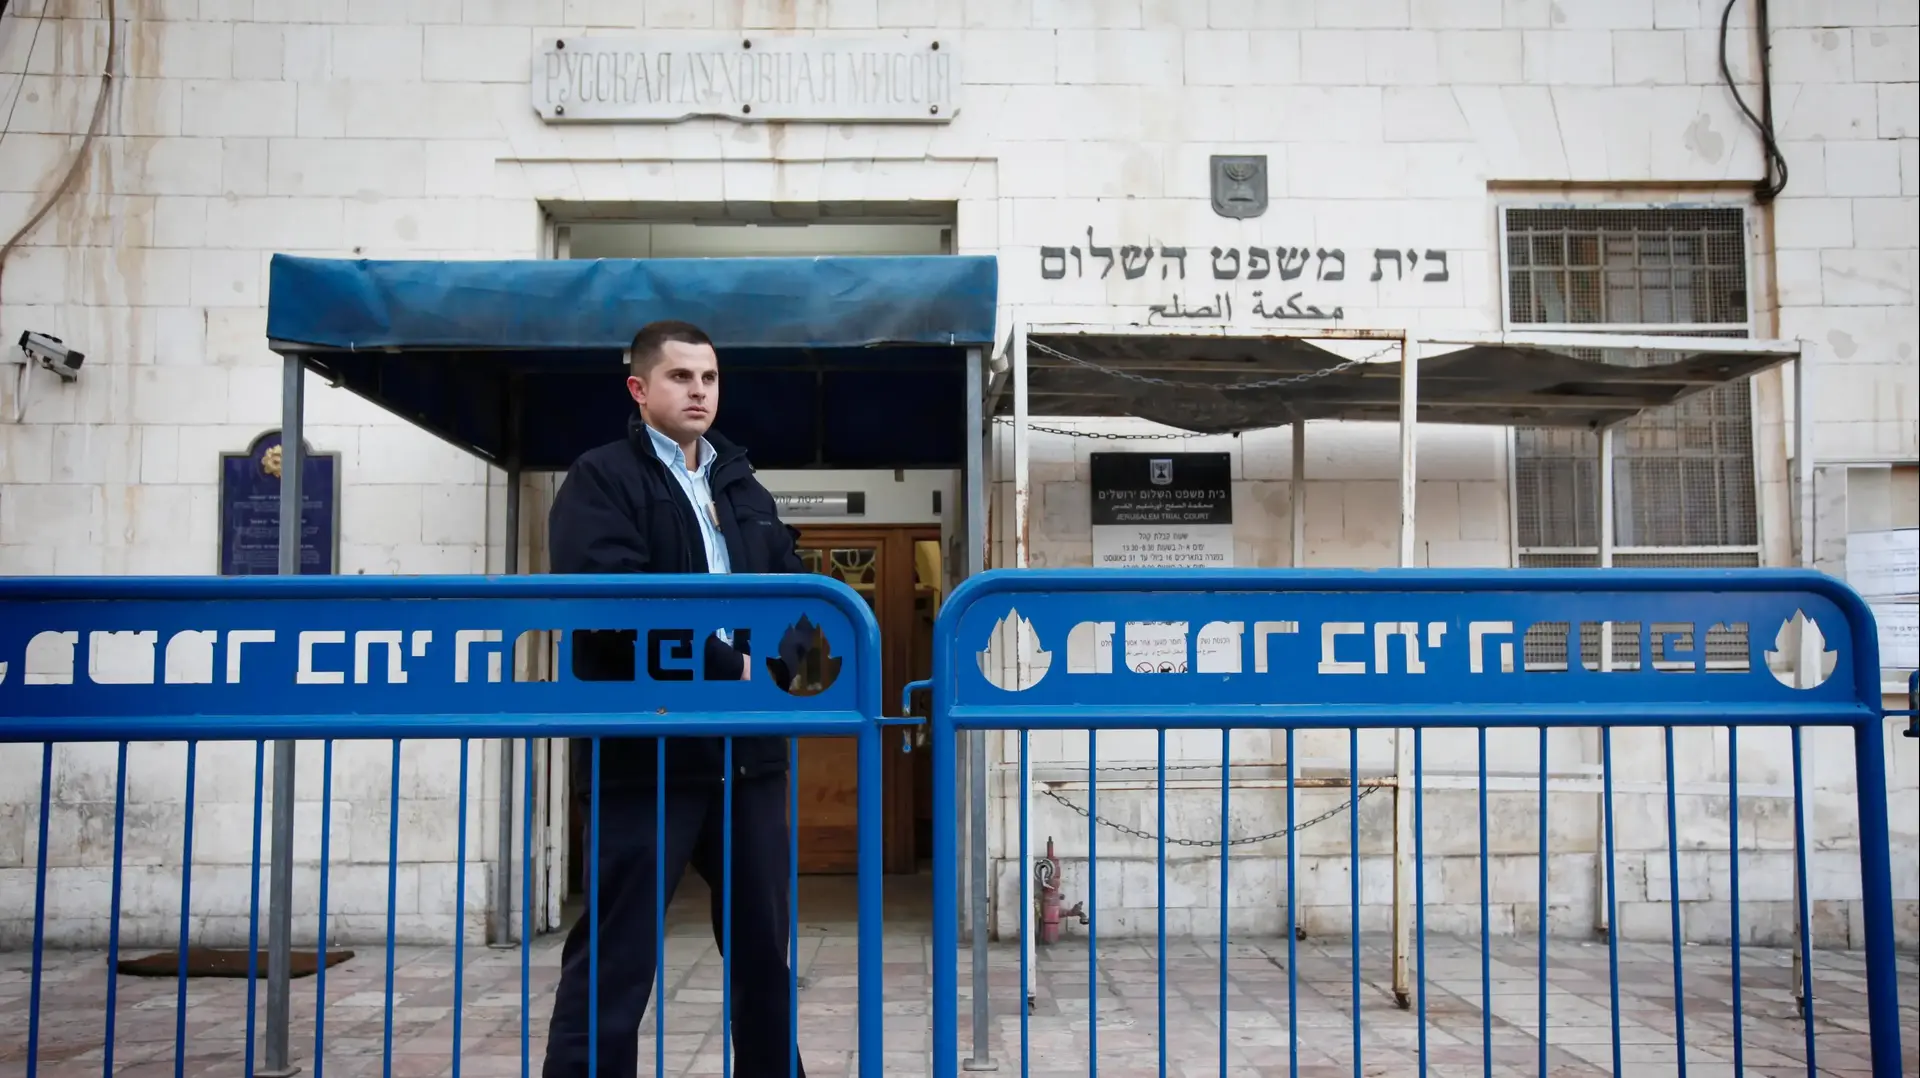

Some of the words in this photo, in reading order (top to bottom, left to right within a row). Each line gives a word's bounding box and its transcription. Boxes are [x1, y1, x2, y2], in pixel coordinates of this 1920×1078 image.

[544, 51, 672, 103] РУССКАЯ
[680, 51, 837, 104] ДУХОВНАЯ
[1040, 225, 1187, 281] השלום
[1210, 246, 1346, 282] משפט
[1370, 247, 1450, 283] בית
[1148, 290, 1232, 326] الصلح
[1252, 290, 1344, 321] محكمة
[1098, 488, 1137, 500] ירושלים
[1139, 488, 1172, 499] השלום
[1174, 489, 1205, 499] משפט
[1208, 489, 1226, 499] בית
[1116, 512, 1160, 521] JERUSALEM
[1161, 512, 1181, 520] TRIAL
[1183, 512, 1210, 520] COURT
